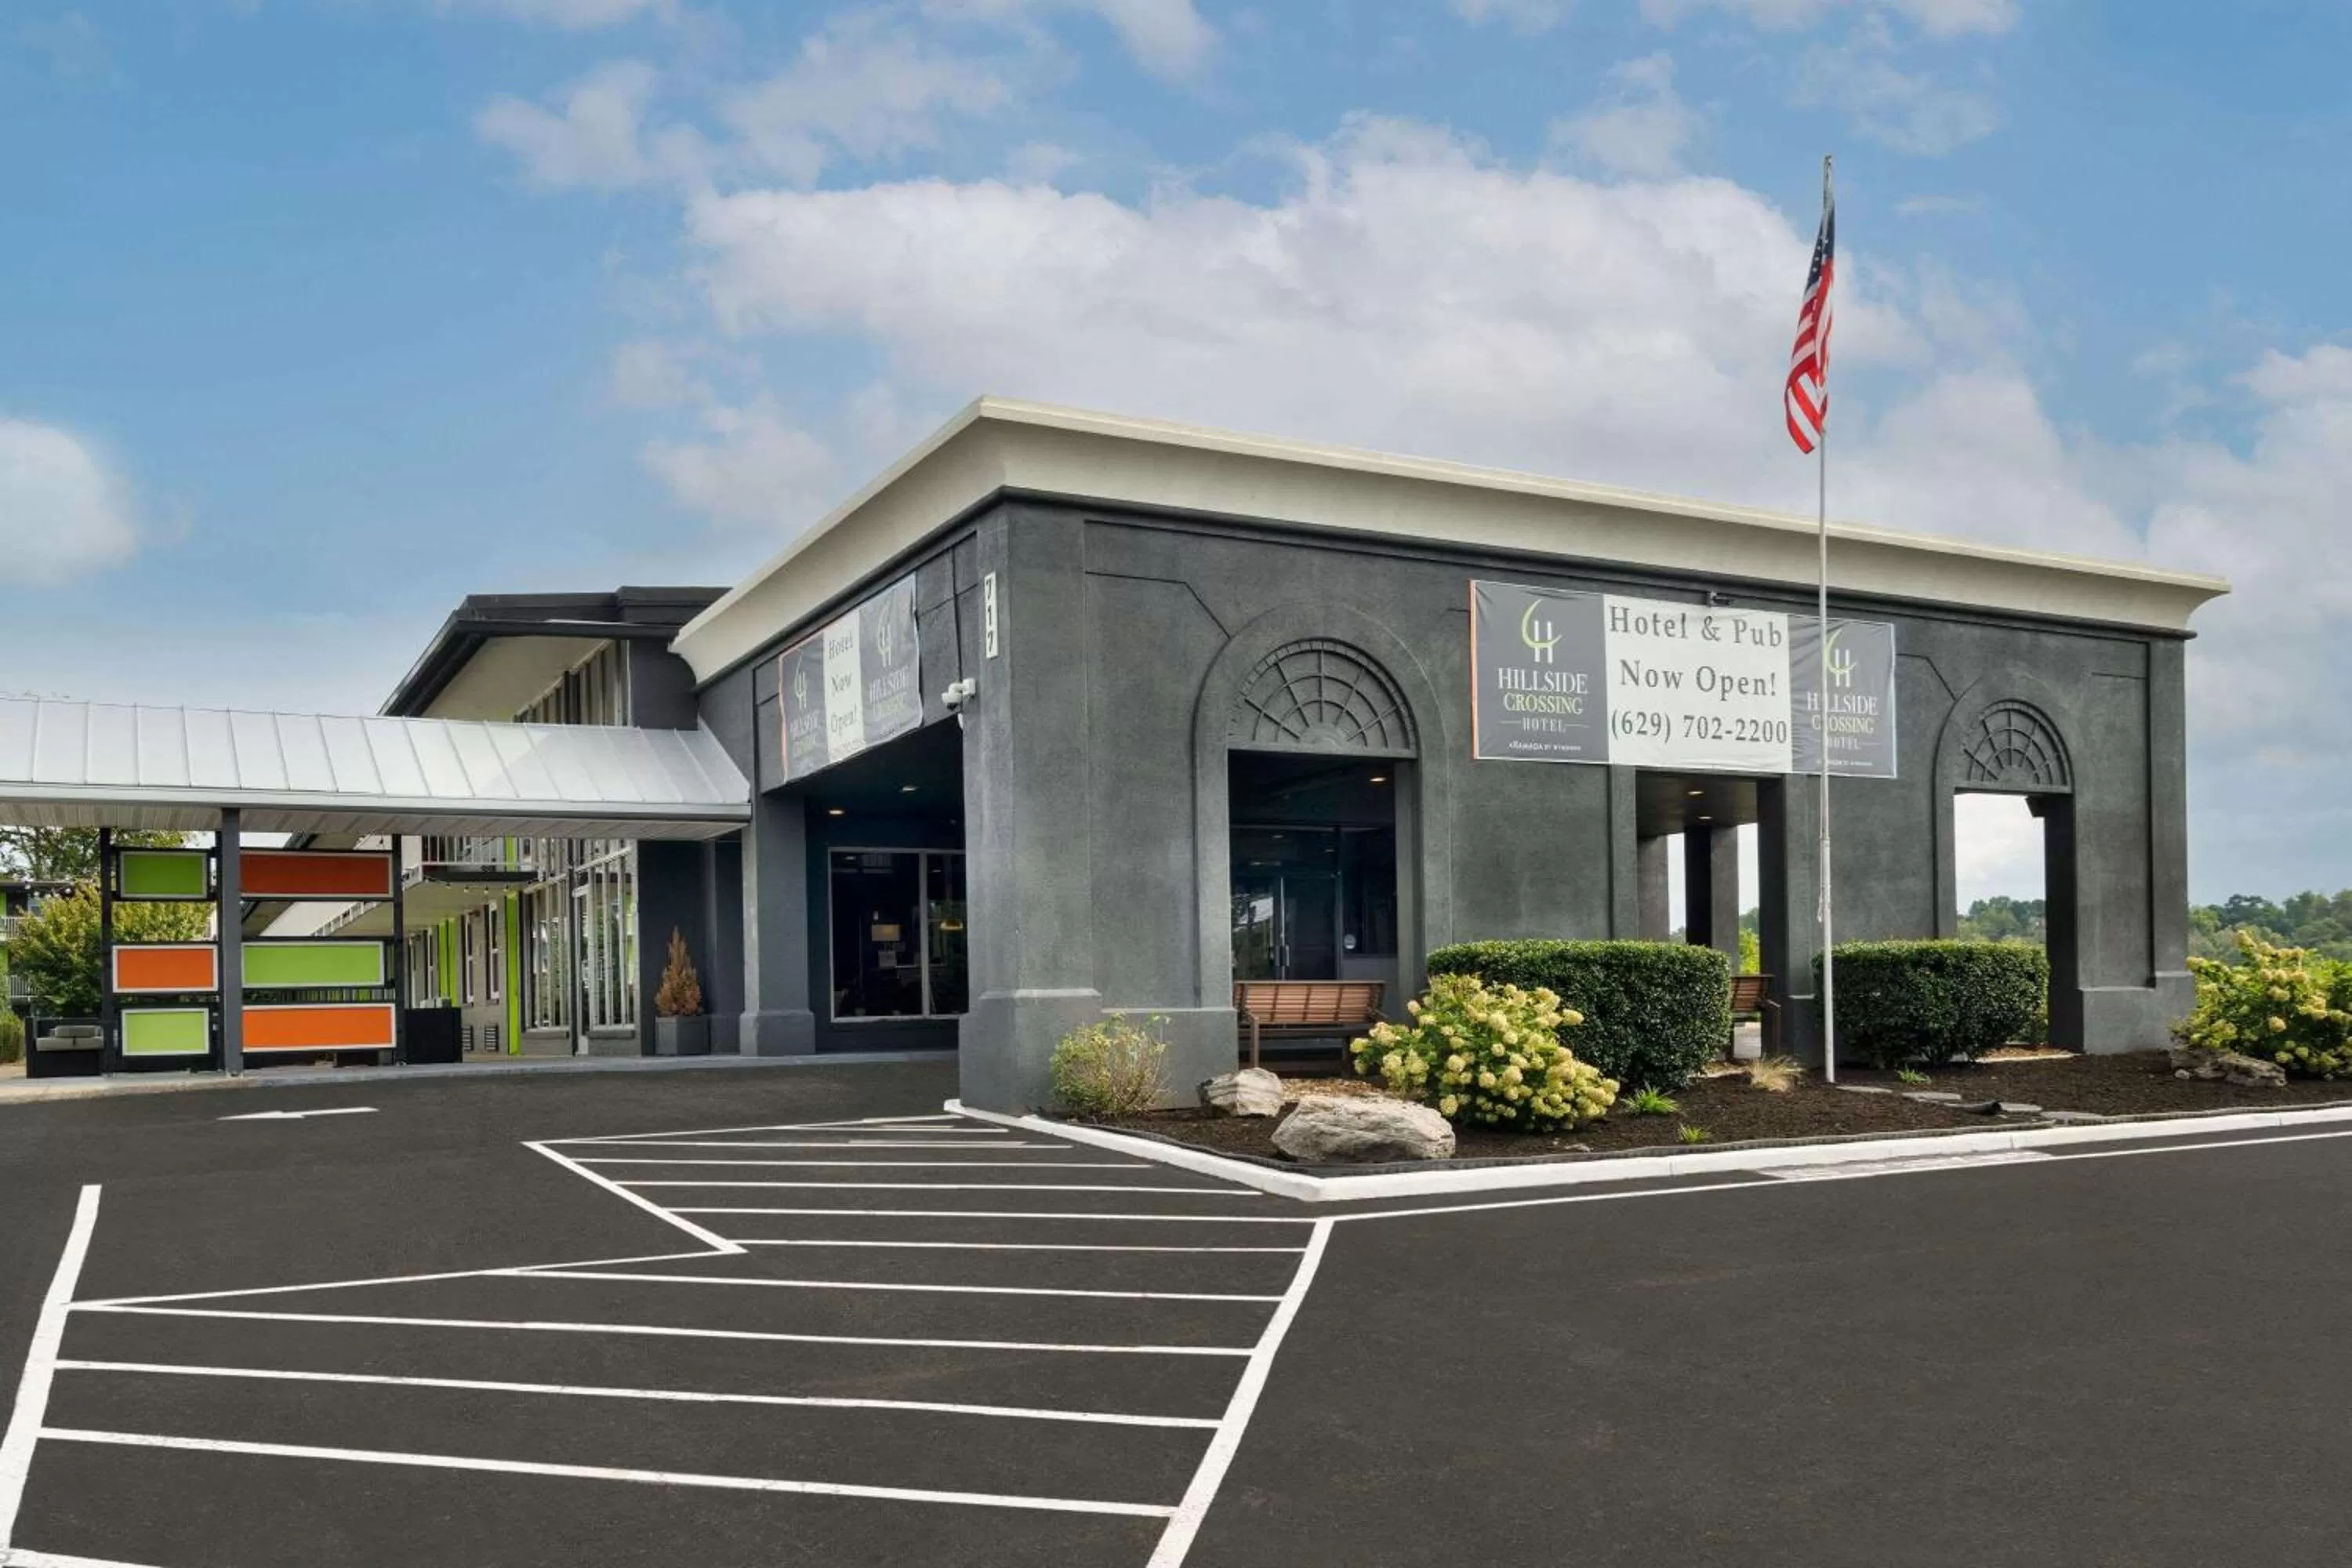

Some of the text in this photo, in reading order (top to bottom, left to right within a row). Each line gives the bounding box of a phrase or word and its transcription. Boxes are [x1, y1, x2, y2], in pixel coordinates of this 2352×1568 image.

[1609, 605, 1782, 648] Hotel & Pub
[1497, 667, 1589, 695] HILLSIDE
[1620, 659, 1777, 702] Now Open!
[1503, 692, 1584, 715] CROSSING
[1523, 717, 1566, 733] HOTEL
[1611, 709, 1788, 744] (629) 702-2200
[1812, 714, 1875, 735] COSSING
